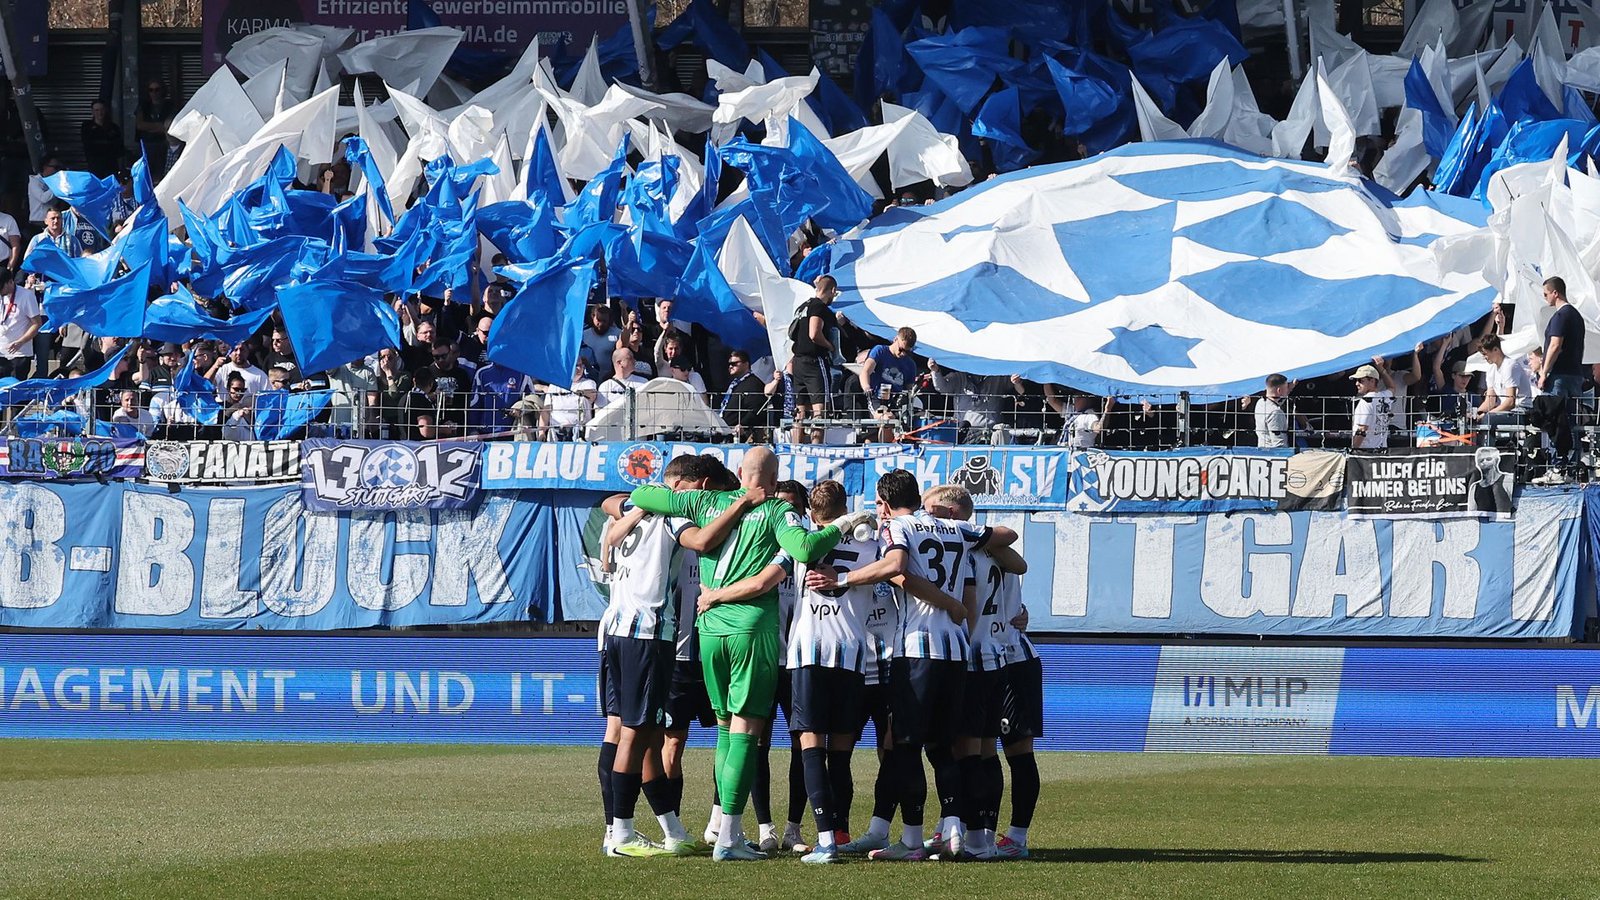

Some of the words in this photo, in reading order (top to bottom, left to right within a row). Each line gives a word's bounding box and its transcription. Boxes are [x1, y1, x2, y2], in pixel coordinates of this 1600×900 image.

[427, 0, 627, 15] ewerbeimmmobilie
[306, 445, 362, 500] 13
[417, 444, 476, 499] 12
[488, 443, 608, 481] BLAUE
[1371, 462, 1412, 479] LUCA
[1416, 458, 1446, 478] FÜR
[1011, 455, 1062, 497] SV
[1097, 458, 1200, 499] YOUNG
[1205, 458, 1287, 499] CARE
[1351, 480, 1404, 498] IMMER
[1435, 478, 1467, 495] UNS
[338, 485, 440, 507] STUTTGART
[0, 482, 515, 618] B-BLOCK
[918, 538, 964, 592] 37
[809, 603, 842, 621] vpv
[0, 667, 317, 713] AGEMENT-
[351, 670, 475, 715] UND
[511, 671, 602, 716] IT-
[1225, 676, 1308, 708] MHP
[1001, 718, 1011, 734] 8
[1196, 717, 1249, 727] PORSCHE
[1254, 718, 1308, 727] COMPANY
[814, 807, 824, 815] 15
